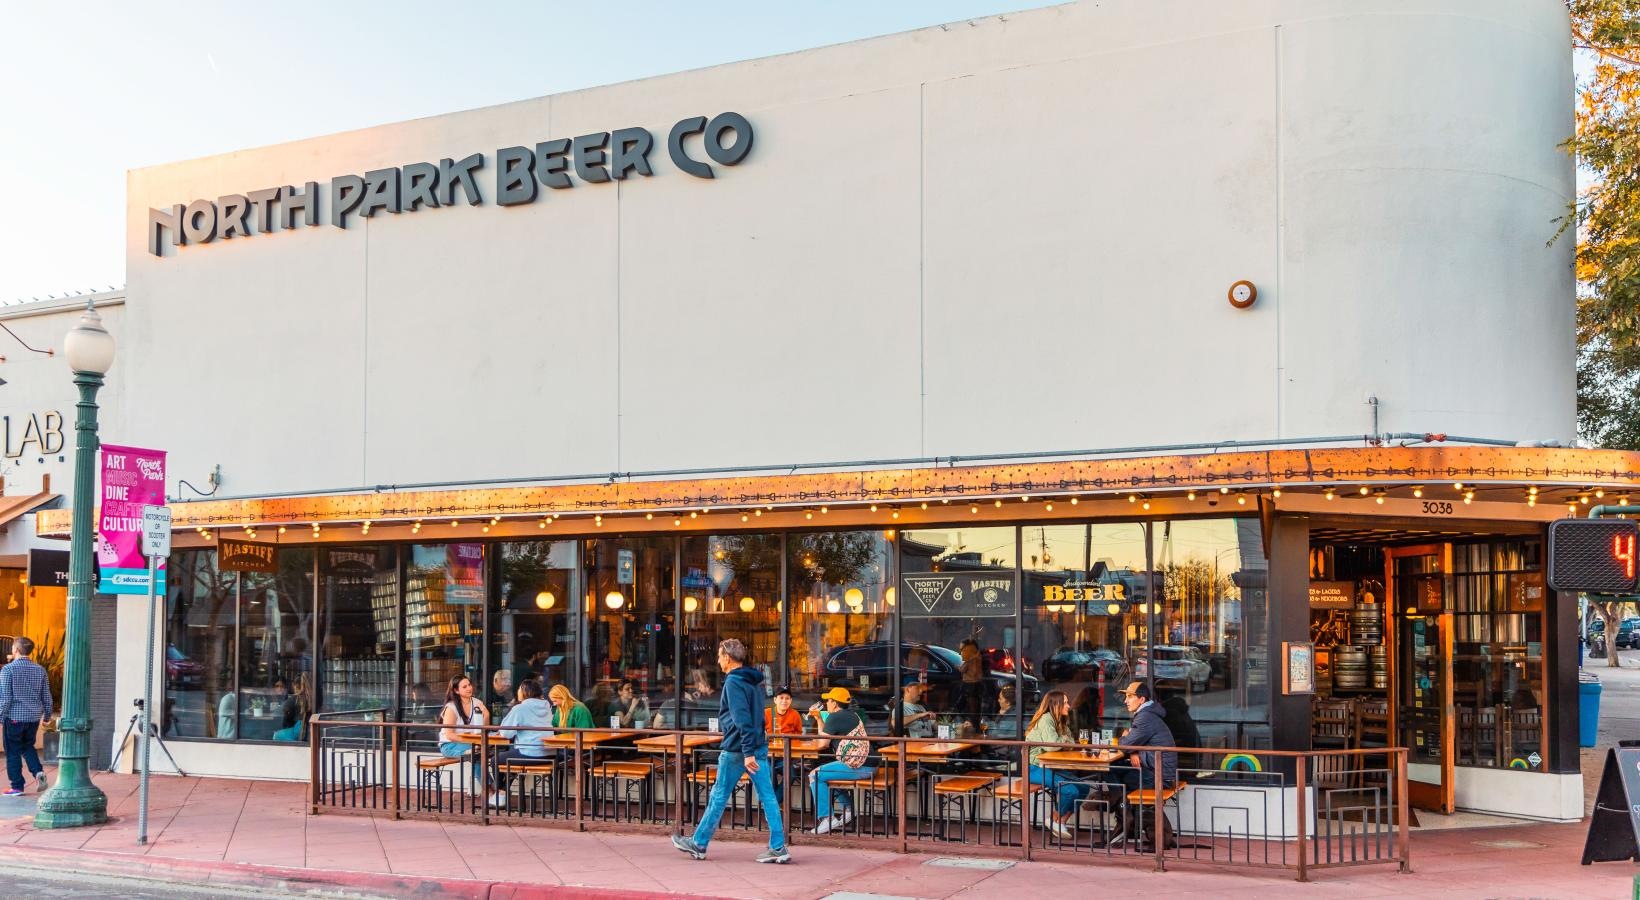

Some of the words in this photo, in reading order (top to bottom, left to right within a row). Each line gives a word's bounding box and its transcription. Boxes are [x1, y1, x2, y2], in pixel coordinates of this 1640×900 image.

[148, 180, 320, 257] NORTH
[332, 153, 484, 229] PARK
[496, 126, 654, 206] BEER
[668, 111, 754, 179] CO
[3, 409, 65, 458] LAB
[106, 454, 127, 470] ART
[136, 457, 162, 472] North
[105, 469, 138, 487] MUSIC
[143, 467, 164, 481] Park
[105, 485, 129, 501] DINE
[104, 500, 144, 518] CRAFTE
[1422, 501, 1453, 514] 3038
[103, 516, 143, 533] CULTUR
[145, 513, 170, 522] MOTORCYCLE
[148, 532, 166, 540] SCOOTER
[223, 542, 274, 564] MASTIFF
[1614, 534, 1635, 579] 4
[55, 571, 69, 580] TH
[914, 580, 944, 589] NORTH
[970, 580, 1011, 593] MASTIFF
[1042, 584, 1127, 601] BEER
[953, 587, 963, 601] &
